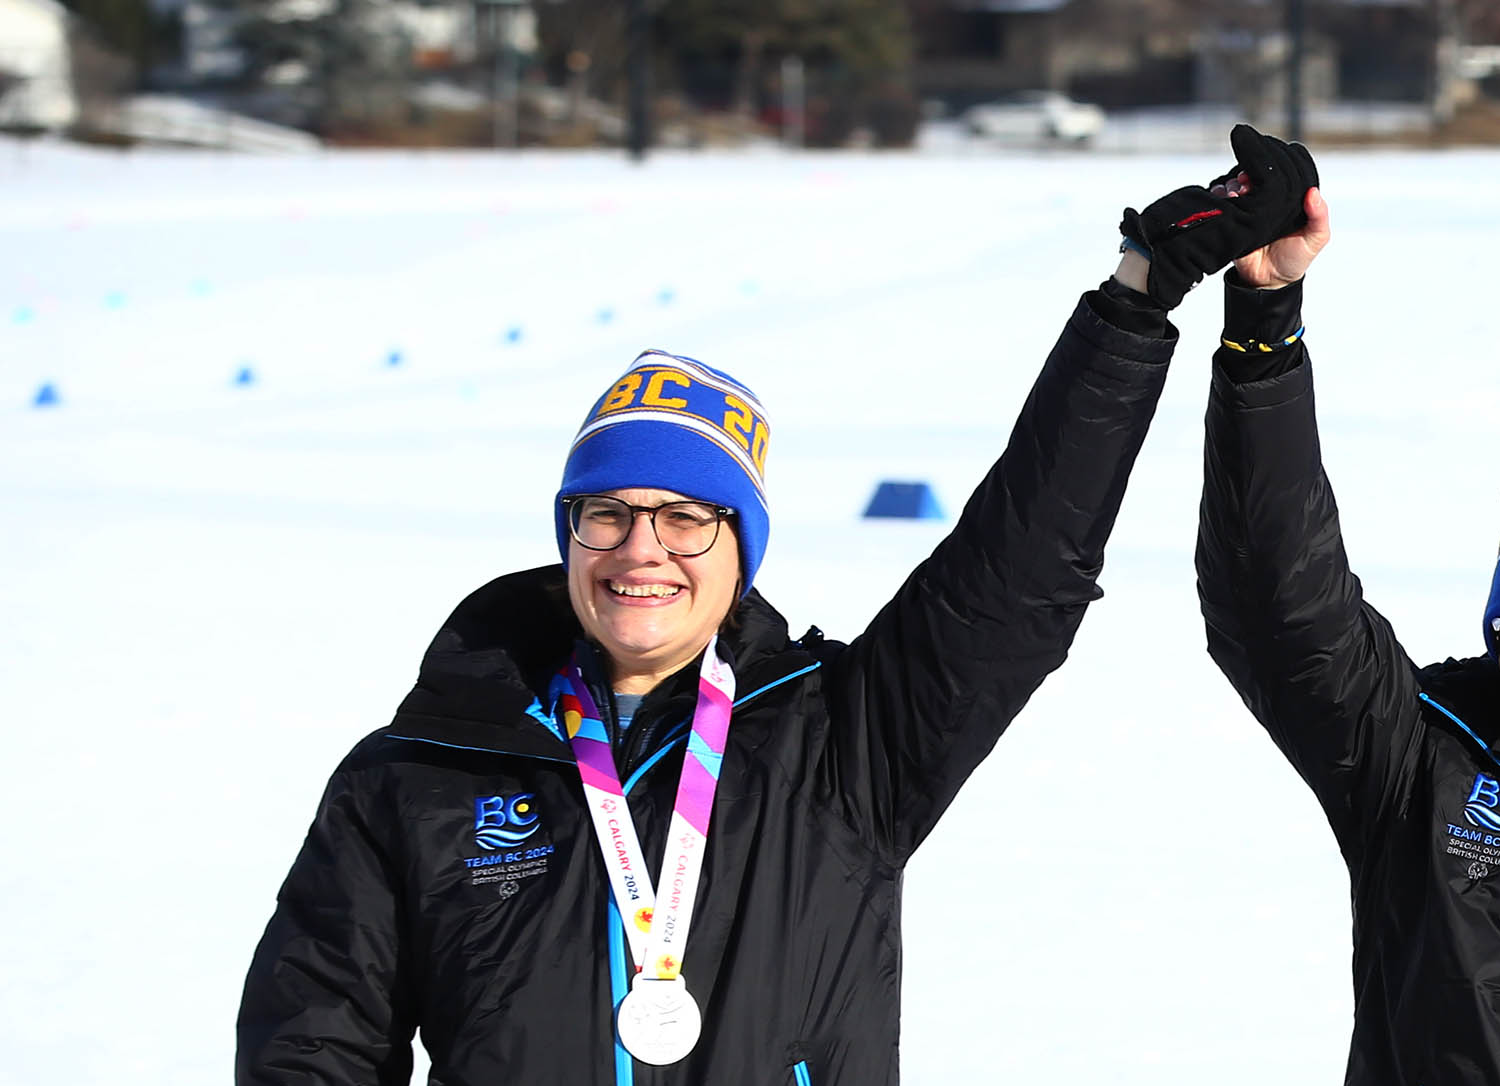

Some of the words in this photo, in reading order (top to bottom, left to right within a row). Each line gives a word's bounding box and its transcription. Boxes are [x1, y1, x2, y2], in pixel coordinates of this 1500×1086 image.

[598, 371, 691, 416] BC
[474, 792, 539, 830] BC
[1447, 823, 1482, 842] TEAM
[1448, 838, 1482, 852] SPECIAL
[464, 854, 502, 868] TEAM
[504, 851, 523, 863] BC
[525, 844, 555, 860] 2024
[608, 818, 632, 871] CALGARY
[624, 874, 640, 901] 2024
[1446, 846, 1478, 860] BRITISH
[669, 855, 689, 912] CALGARY
